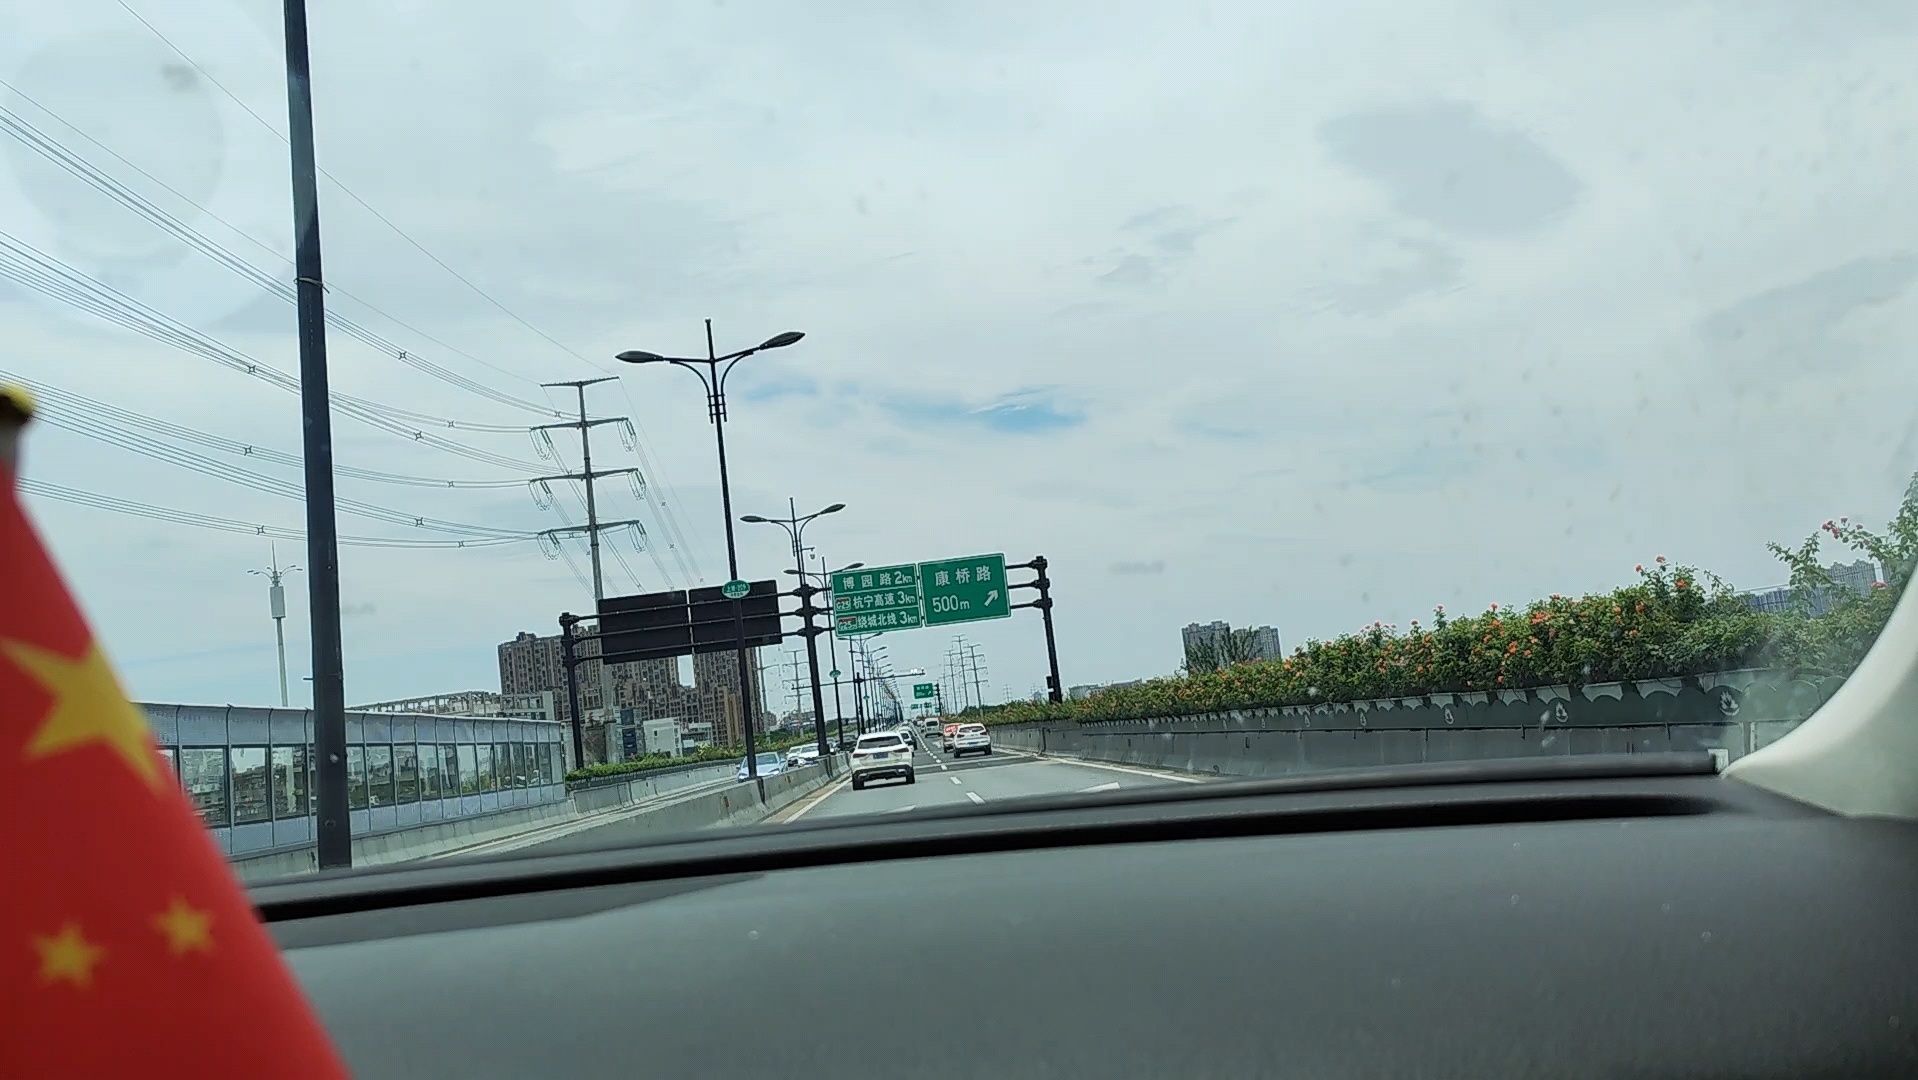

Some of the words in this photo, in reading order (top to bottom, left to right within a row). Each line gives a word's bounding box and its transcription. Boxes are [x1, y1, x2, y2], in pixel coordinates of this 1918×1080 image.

[842, 572, 892, 590] 博园路
[894, 571, 913, 585] 2km
[935, 565, 991, 587] 康桥路
[853, 592, 896, 609] 杭宁高速
[897, 591, 916, 604] 3km
[932, 595, 970, 613] 500m
[858, 612, 898, 628] 绕城北线
[900, 611, 918, 624] 3km
